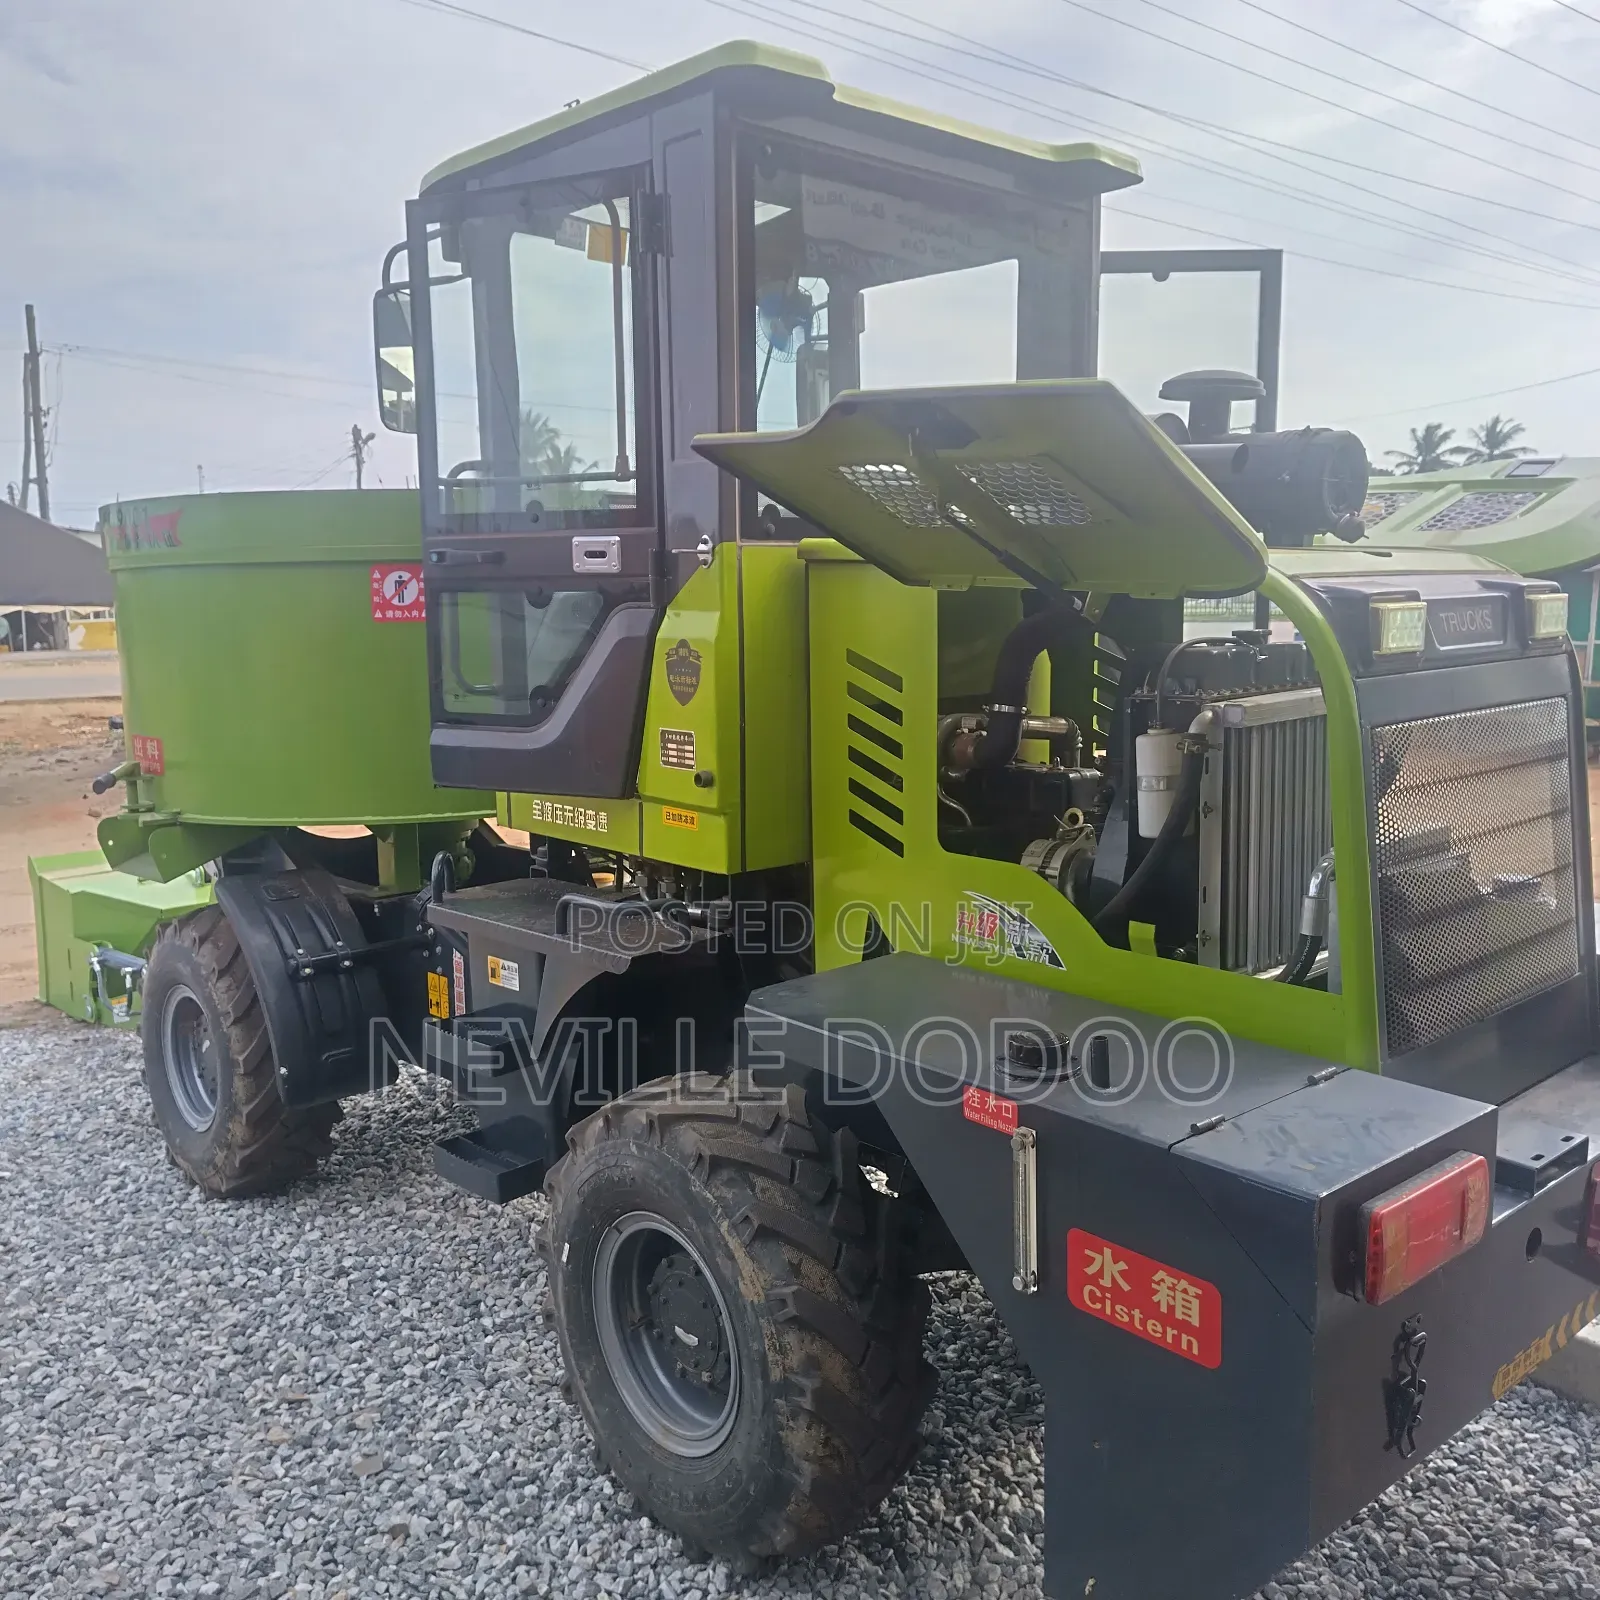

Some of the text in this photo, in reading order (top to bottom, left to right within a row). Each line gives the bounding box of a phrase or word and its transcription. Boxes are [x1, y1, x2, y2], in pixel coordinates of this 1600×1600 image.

[1439, 609, 1493, 633] TRUCKS
[532, 799, 608, 833] 全液压无级变速
[951, 933, 1016, 957] NEW STYLE
[964, 1106, 981, 1121] Water
[980, 1112, 998, 1129] Filling
[968, 1088, 1012, 1119] 注水口
[1083, 1246, 1203, 1328] 水箱
[1083, 1284, 1199, 1356] Cistern
